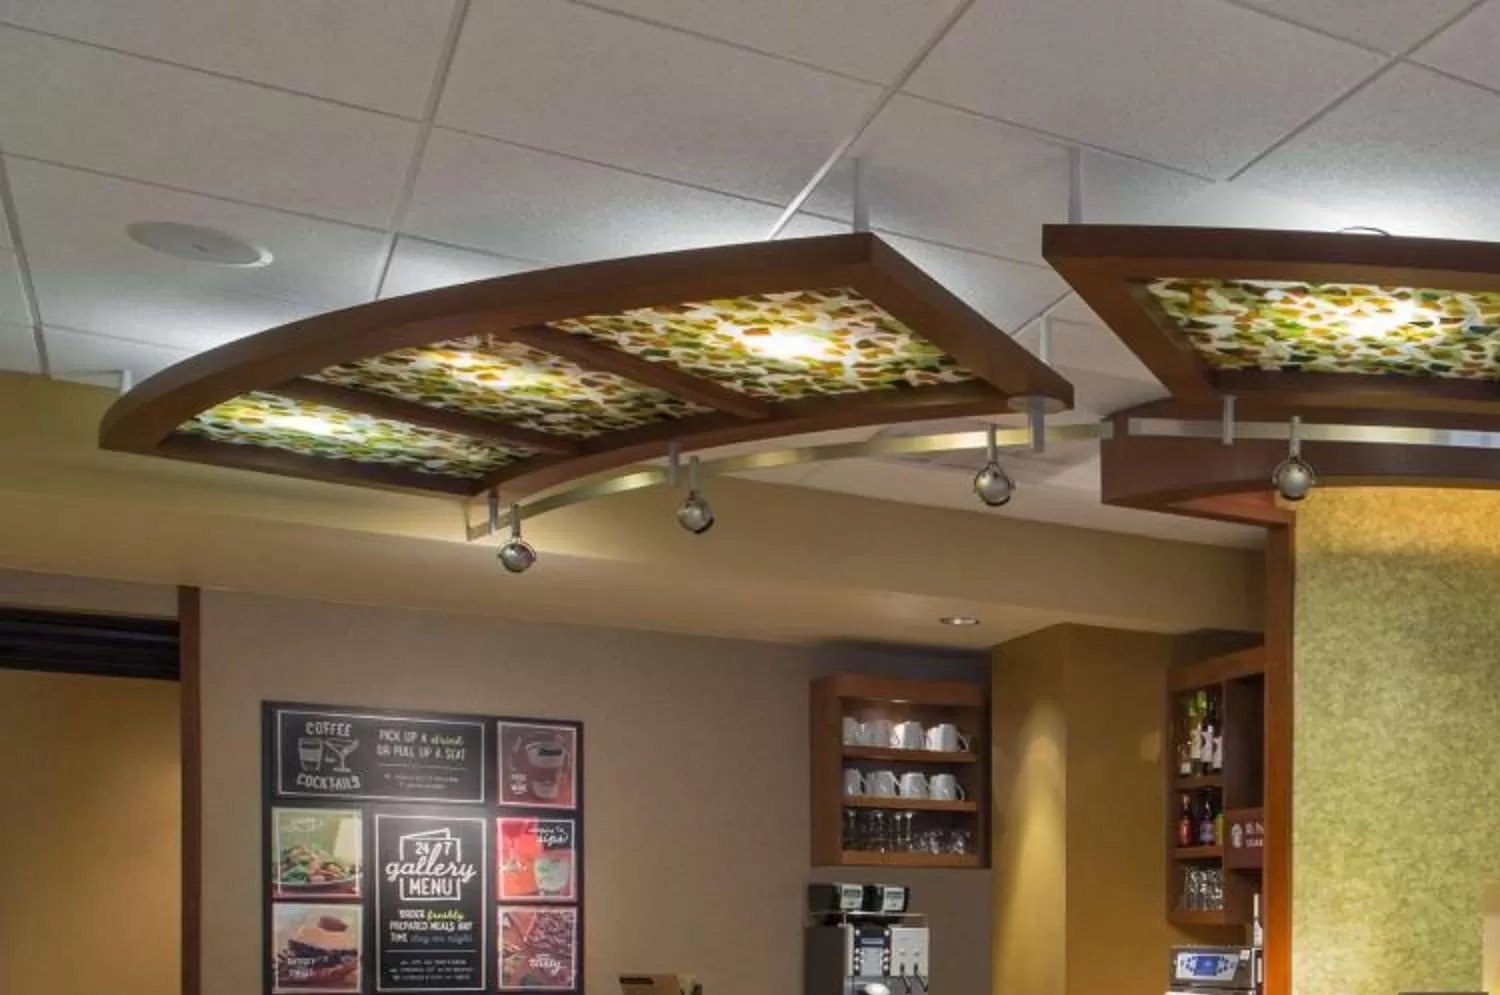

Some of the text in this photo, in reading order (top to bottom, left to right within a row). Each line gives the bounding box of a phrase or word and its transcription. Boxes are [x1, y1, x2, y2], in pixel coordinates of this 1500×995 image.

[305, 721, 352, 737] COFFEE
[379, 728, 400, 742] PICK
[403, 731, 418, 743] UP
[420, 733, 428, 744] A
[376, 744, 391, 756] OR
[393, 744, 415, 758] PULL
[419, 746, 433, 759] UP
[435, 748, 442, 759] A
[296, 773, 362, 792] COCKTAILS
[385, 842, 477, 883] gallery
[409, 877, 453, 896] MENU
